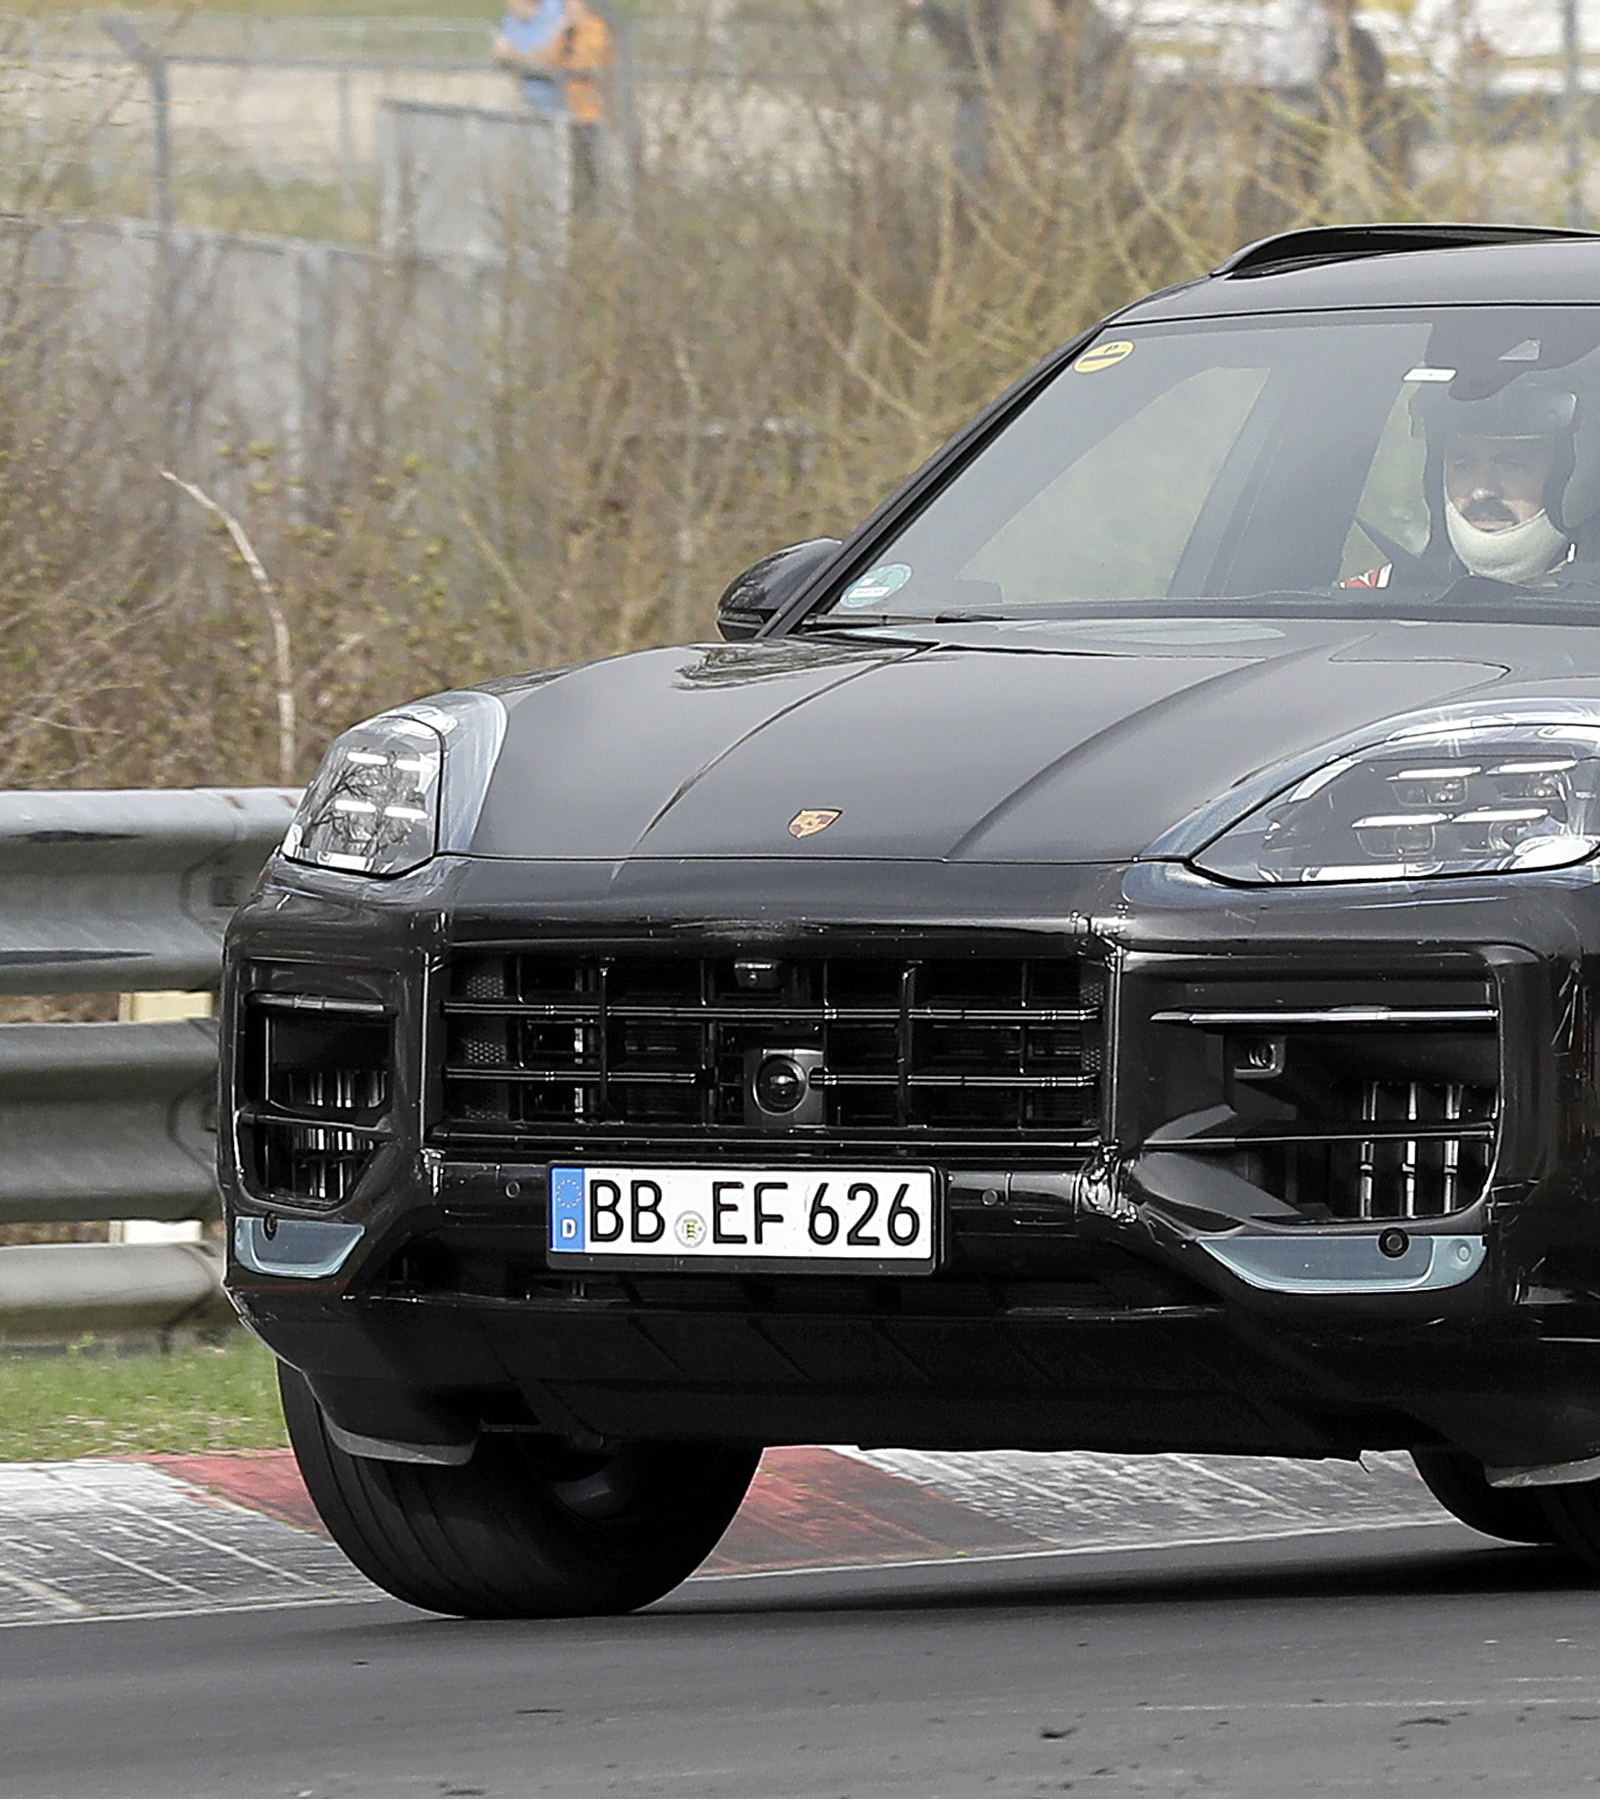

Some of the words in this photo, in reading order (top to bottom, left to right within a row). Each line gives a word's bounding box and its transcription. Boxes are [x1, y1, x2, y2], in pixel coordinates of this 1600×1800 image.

[562, 1219, 576, 1238] D
[590, 1180, 665, 1242] BB
[712, 1181, 788, 1244] EF
[808, 1182, 920, 1246] 626
